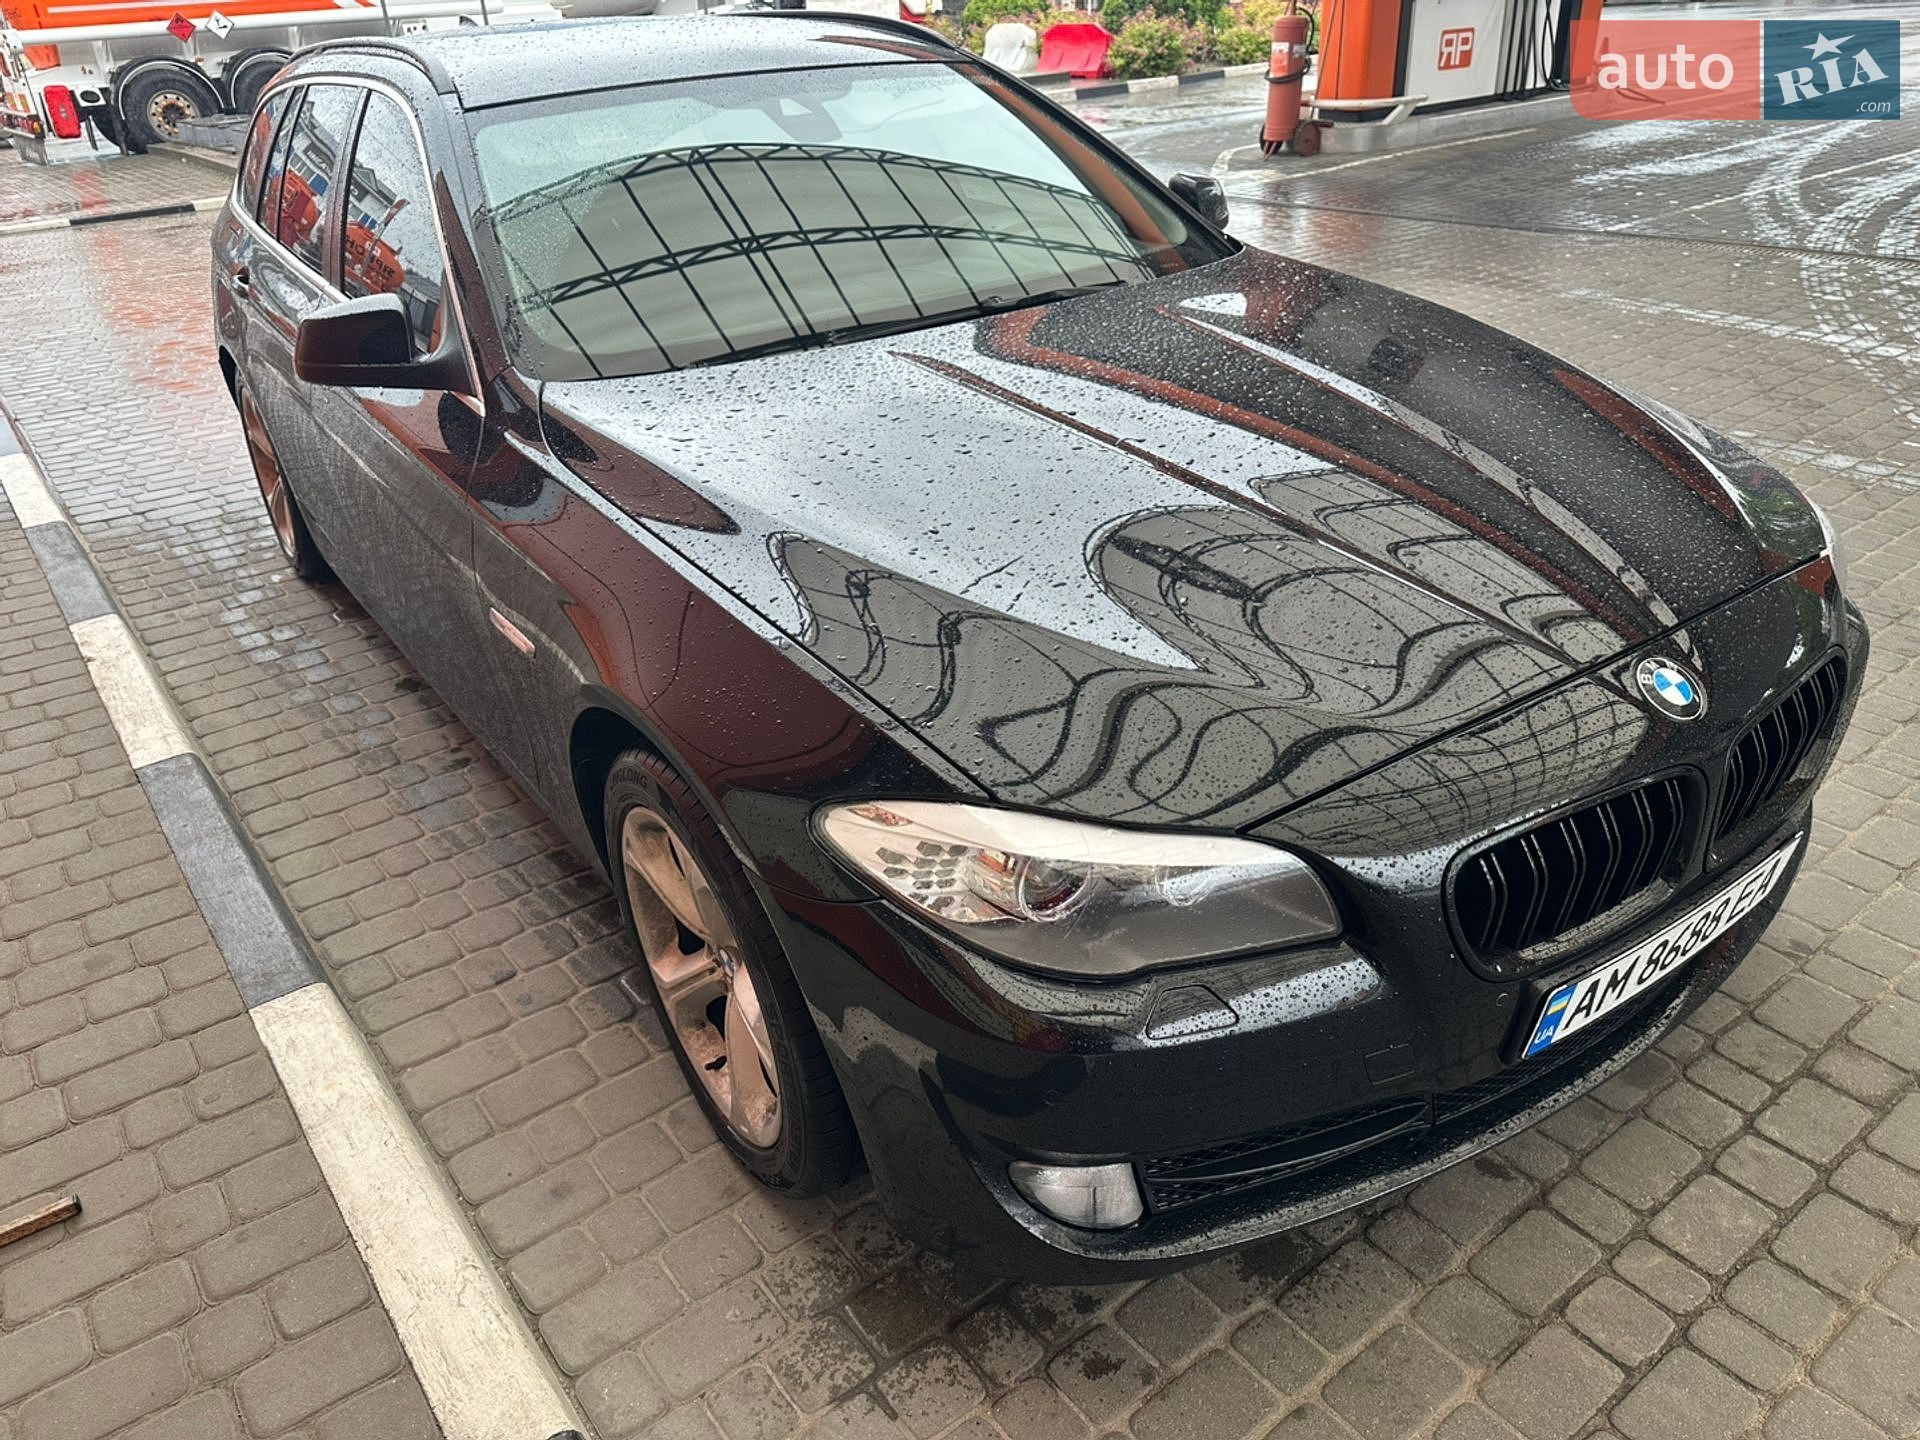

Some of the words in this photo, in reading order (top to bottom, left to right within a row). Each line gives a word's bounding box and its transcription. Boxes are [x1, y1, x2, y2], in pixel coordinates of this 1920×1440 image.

[1563, 955, 1641, 1030] AM
[1637, 899, 1732, 986] 8688
[1725, 857, 1783, 926] EA
[1534, 1025, 1555, 1043] UA
